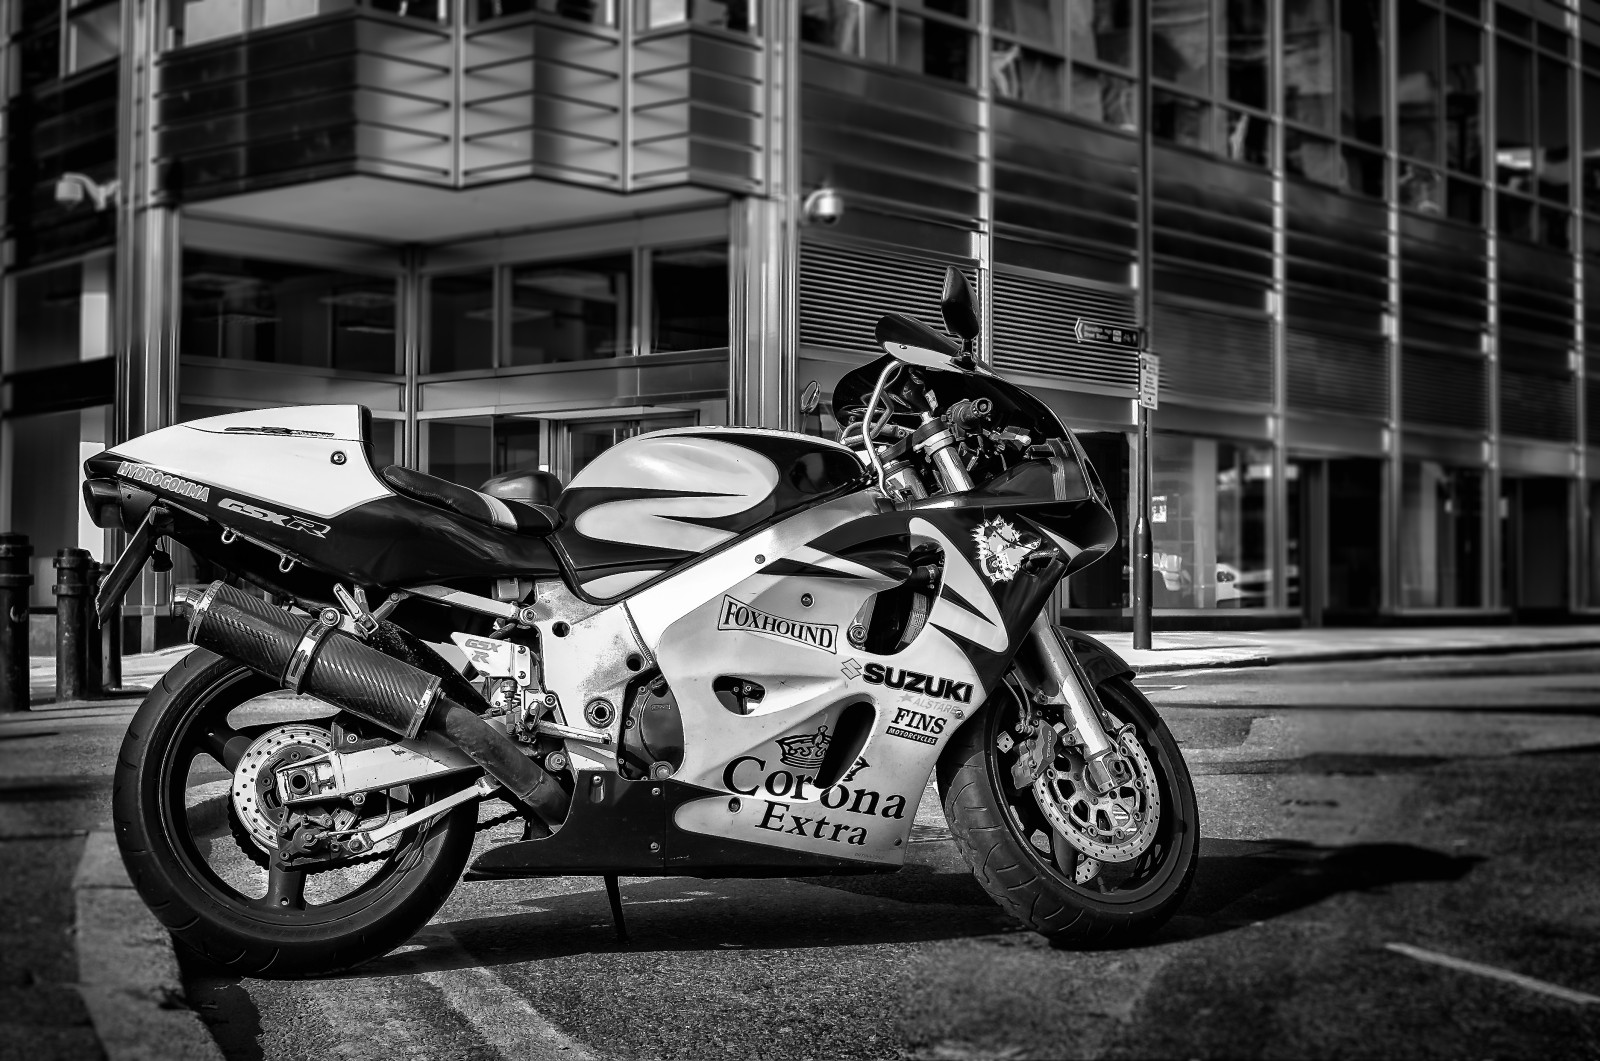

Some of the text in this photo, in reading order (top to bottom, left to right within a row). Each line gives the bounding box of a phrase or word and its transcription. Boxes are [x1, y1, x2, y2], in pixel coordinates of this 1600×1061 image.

[117, 461, 210, 503] HYDROGOMMA
[465, 638, 502, 653] GSX
[723, 601, 833, 649] FOXHOUND
[471, 650, 490, 665] R
[862, 662, 974, 704] SUZUKI
[887, 727, 937, 745] MOTORCYCLES
[891, 706, 948, 735] FINS
[722, 755, 906, 820] Corona
[754, 799, 869, 846] Extra
